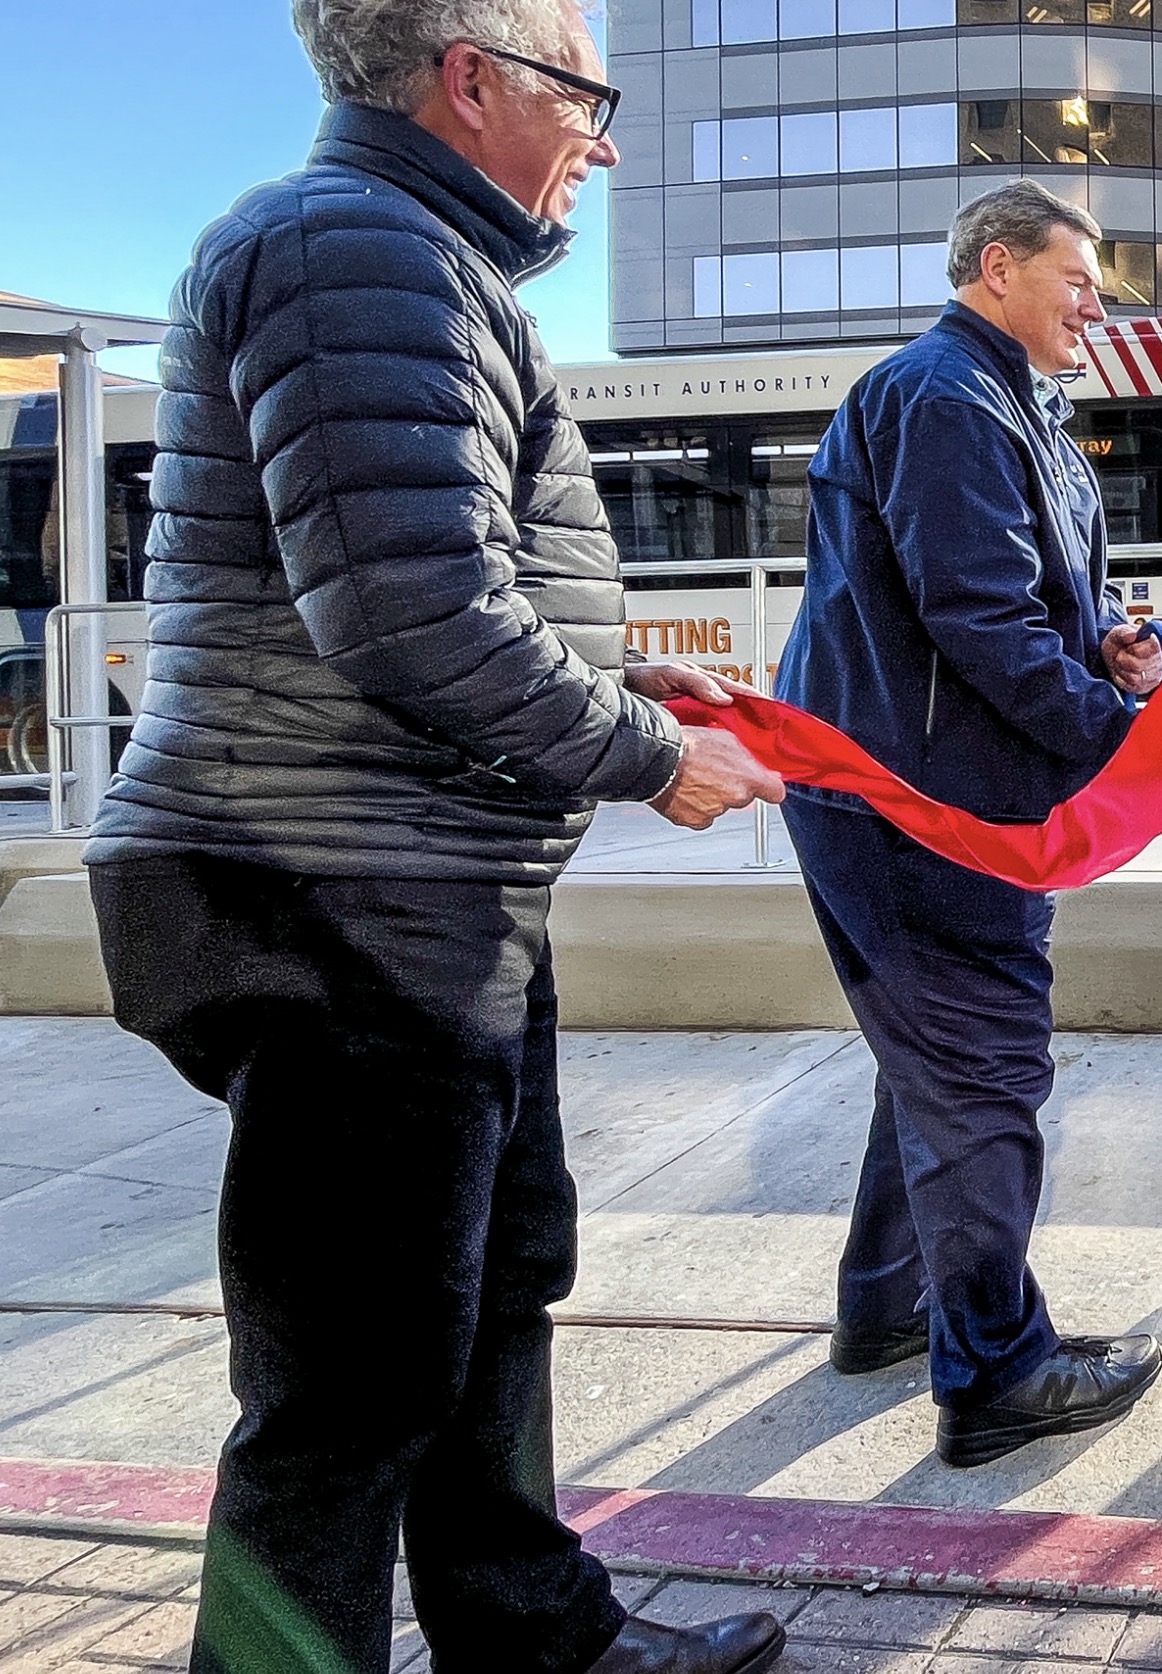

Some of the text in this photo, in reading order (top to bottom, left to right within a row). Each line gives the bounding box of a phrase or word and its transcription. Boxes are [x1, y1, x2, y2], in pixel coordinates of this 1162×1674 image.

[569, 375, 830, 400] RANSIT AUTHORITY
[1076, 439, 1112, 455] ray
